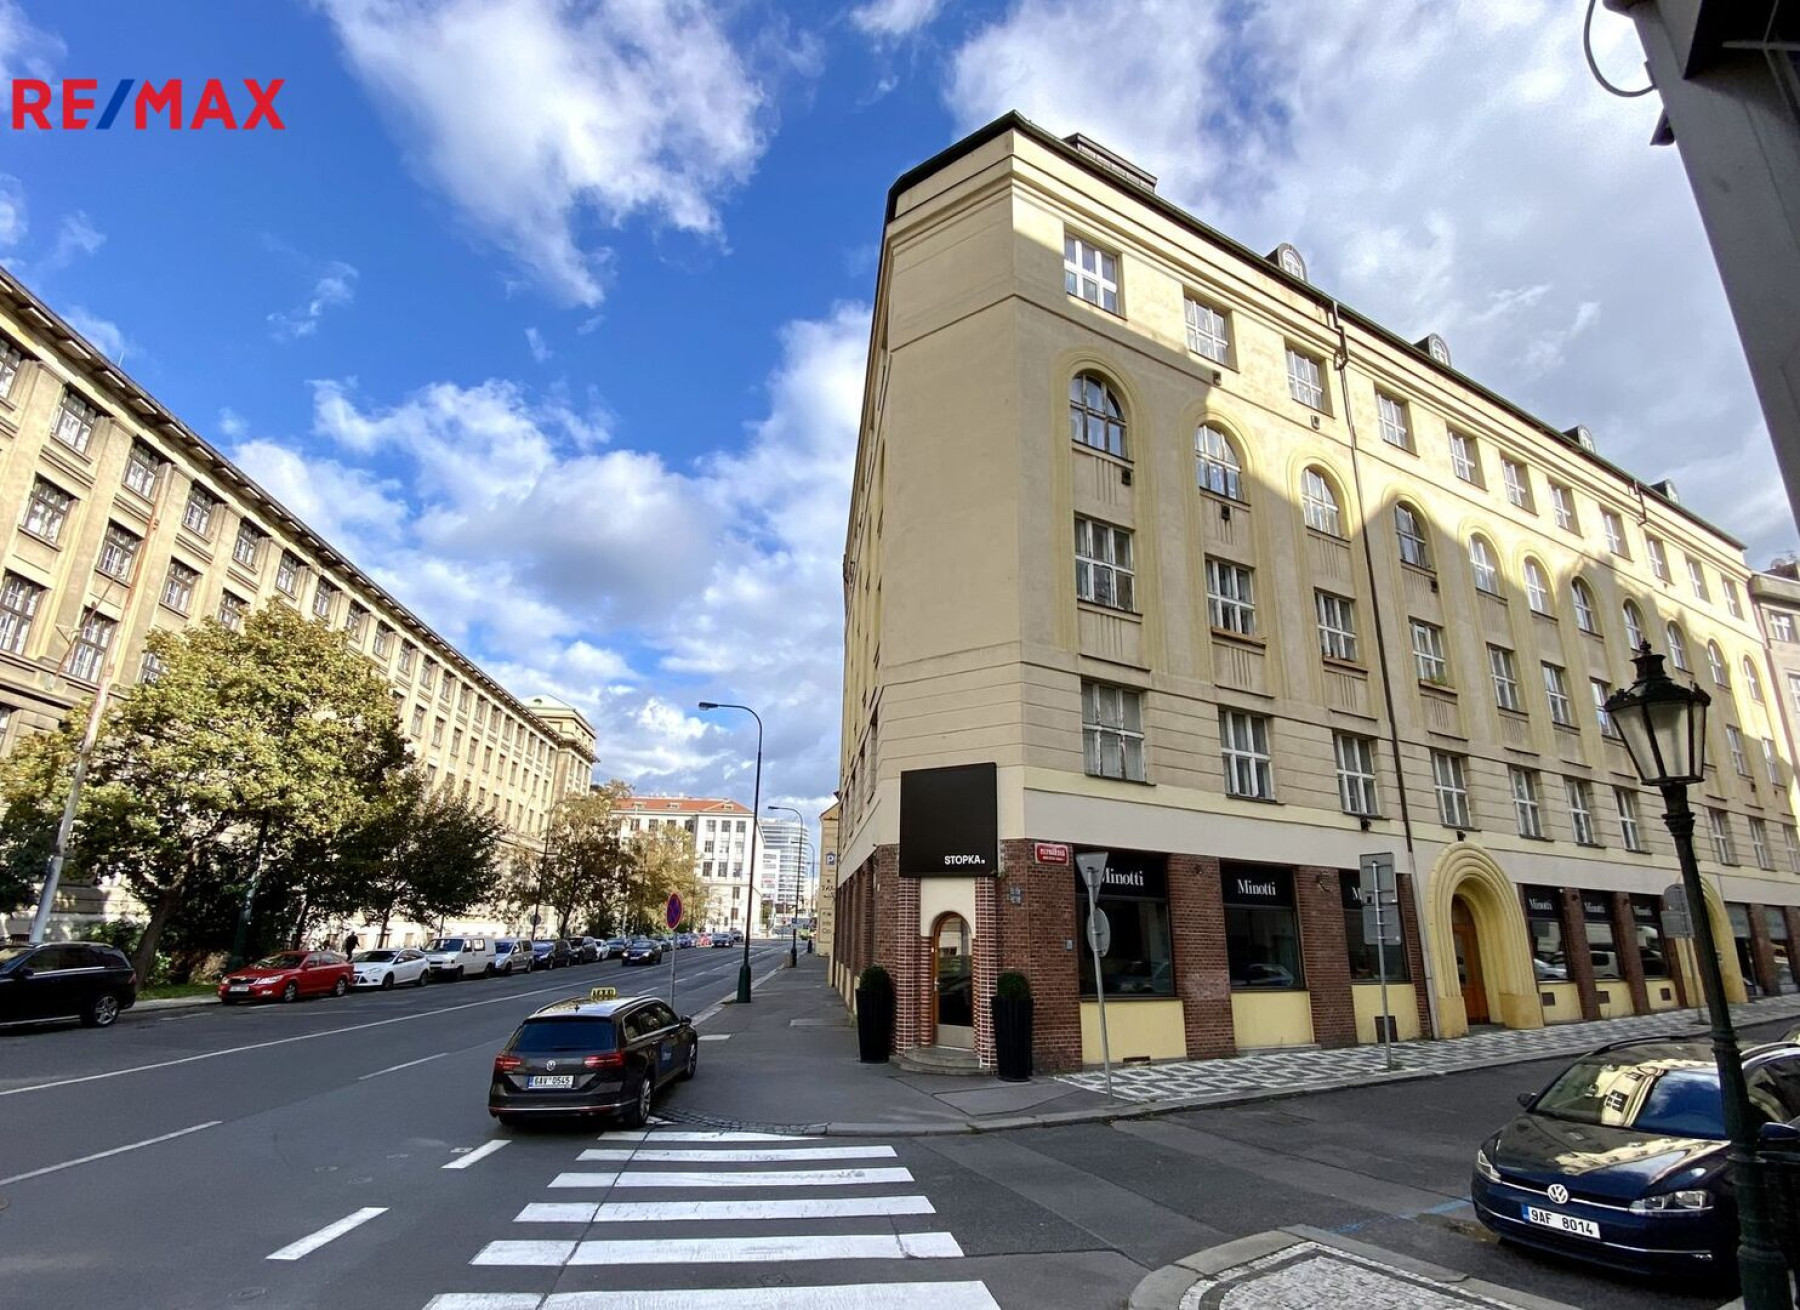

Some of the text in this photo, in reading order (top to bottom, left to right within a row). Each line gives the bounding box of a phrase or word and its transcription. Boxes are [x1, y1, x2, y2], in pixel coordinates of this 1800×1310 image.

[944, 854, 986, 866] STOPKA.
[1237, 879, 1276, 896] Minotti
[1531, 1209, 1594, 1235] 9AF 8014
